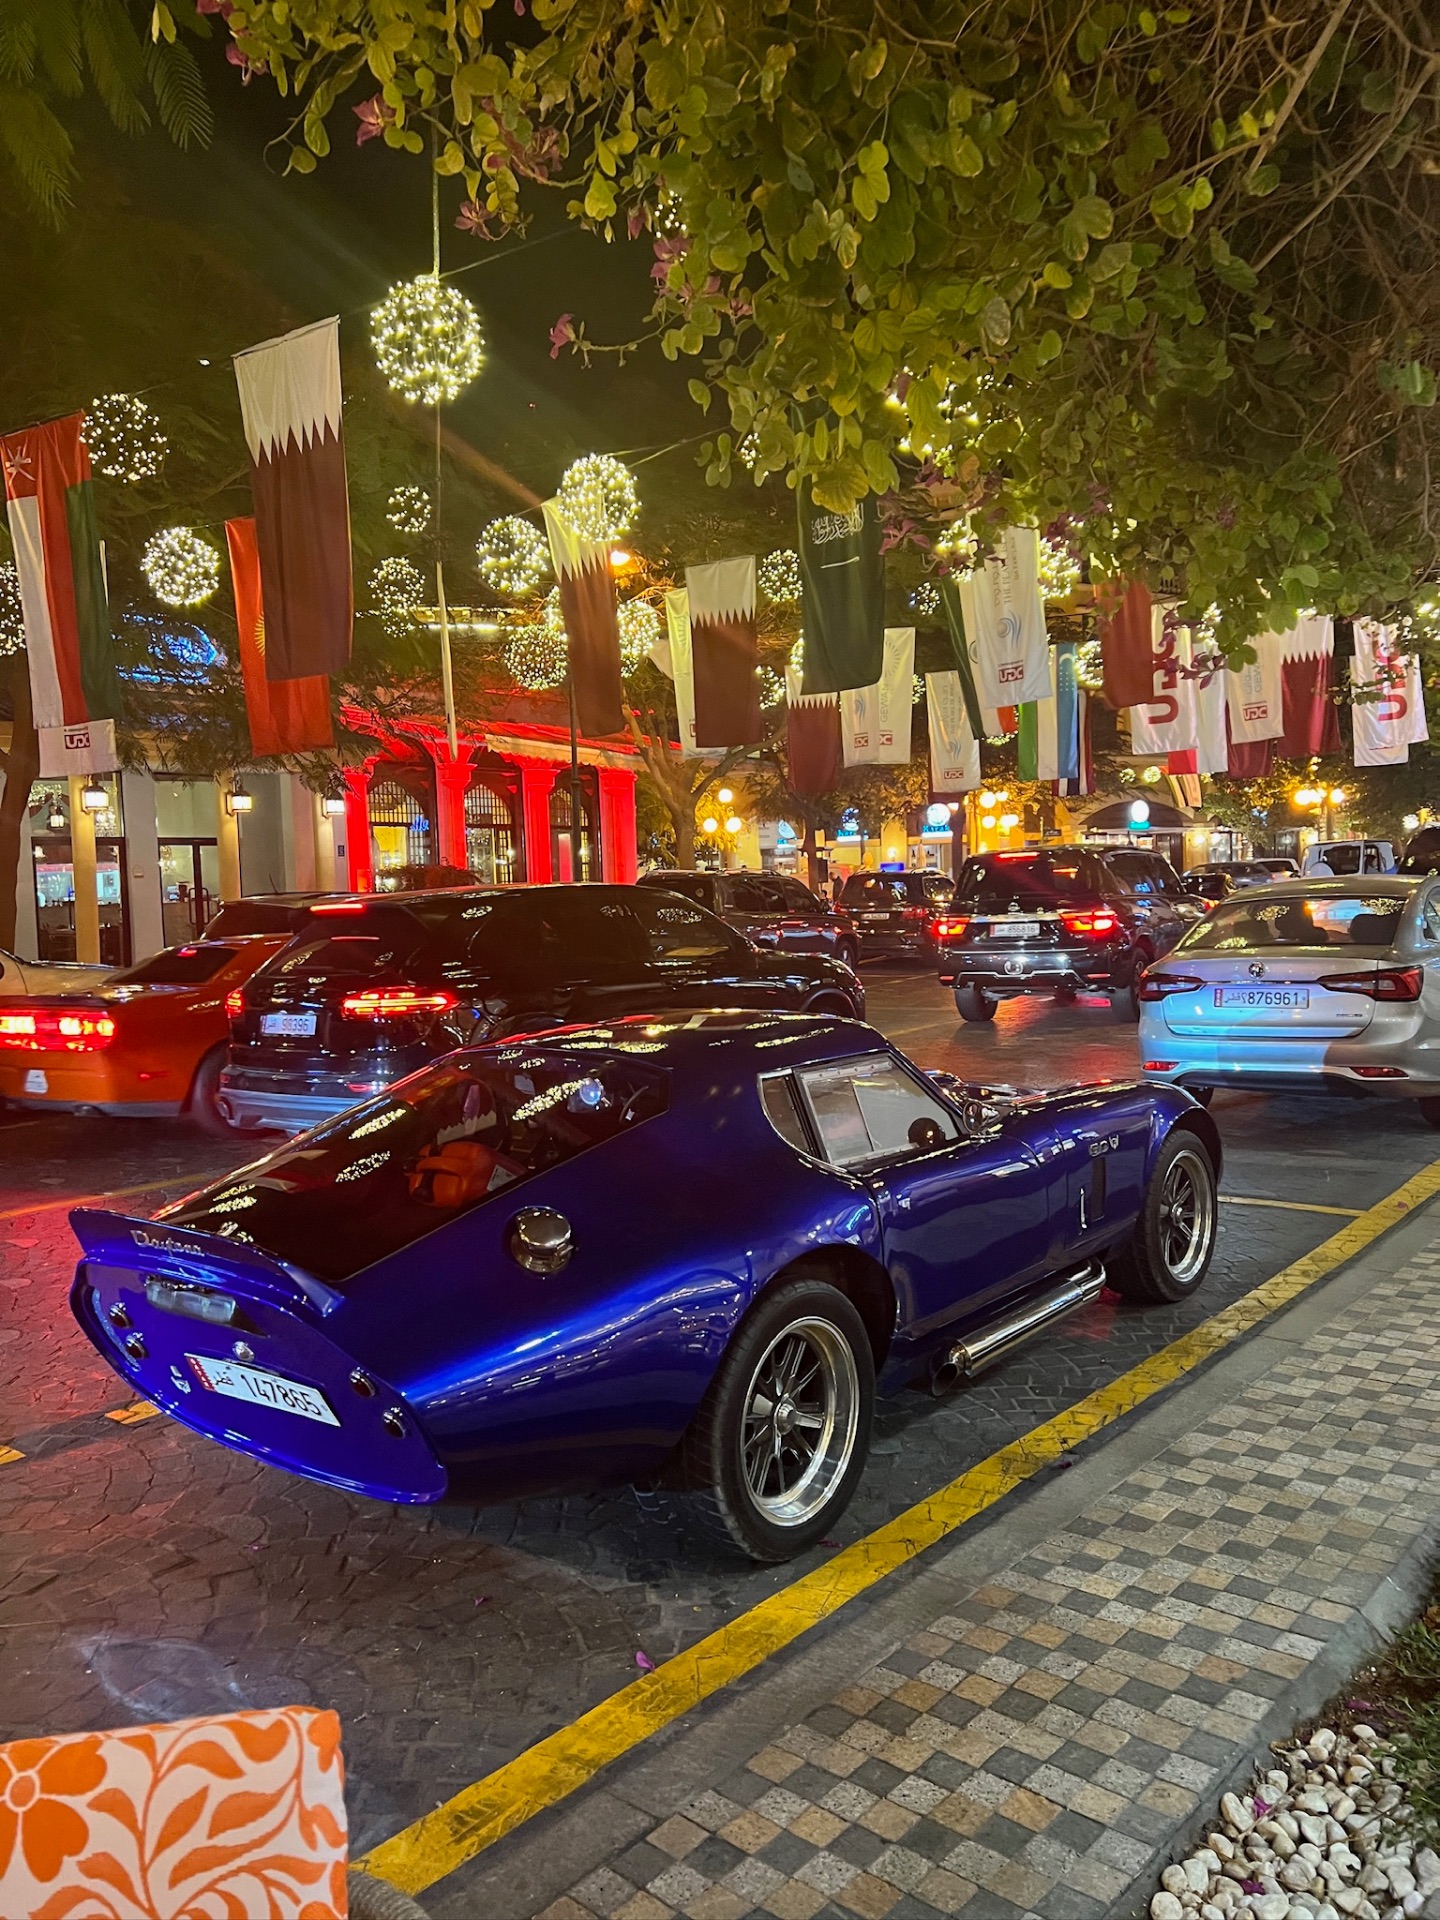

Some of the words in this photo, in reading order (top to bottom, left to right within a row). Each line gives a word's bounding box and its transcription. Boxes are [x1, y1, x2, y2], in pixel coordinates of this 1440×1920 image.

[999, 666, 1024, 683] UDC
[880, 684, 890, 723] GEWAN
[1243, 706, 1268, 721] UDC
[944, 770, 964, 779] UDC
[1247, 991, 1299, 1006] 876961
[240, 1373, 323, 1417] 147865
